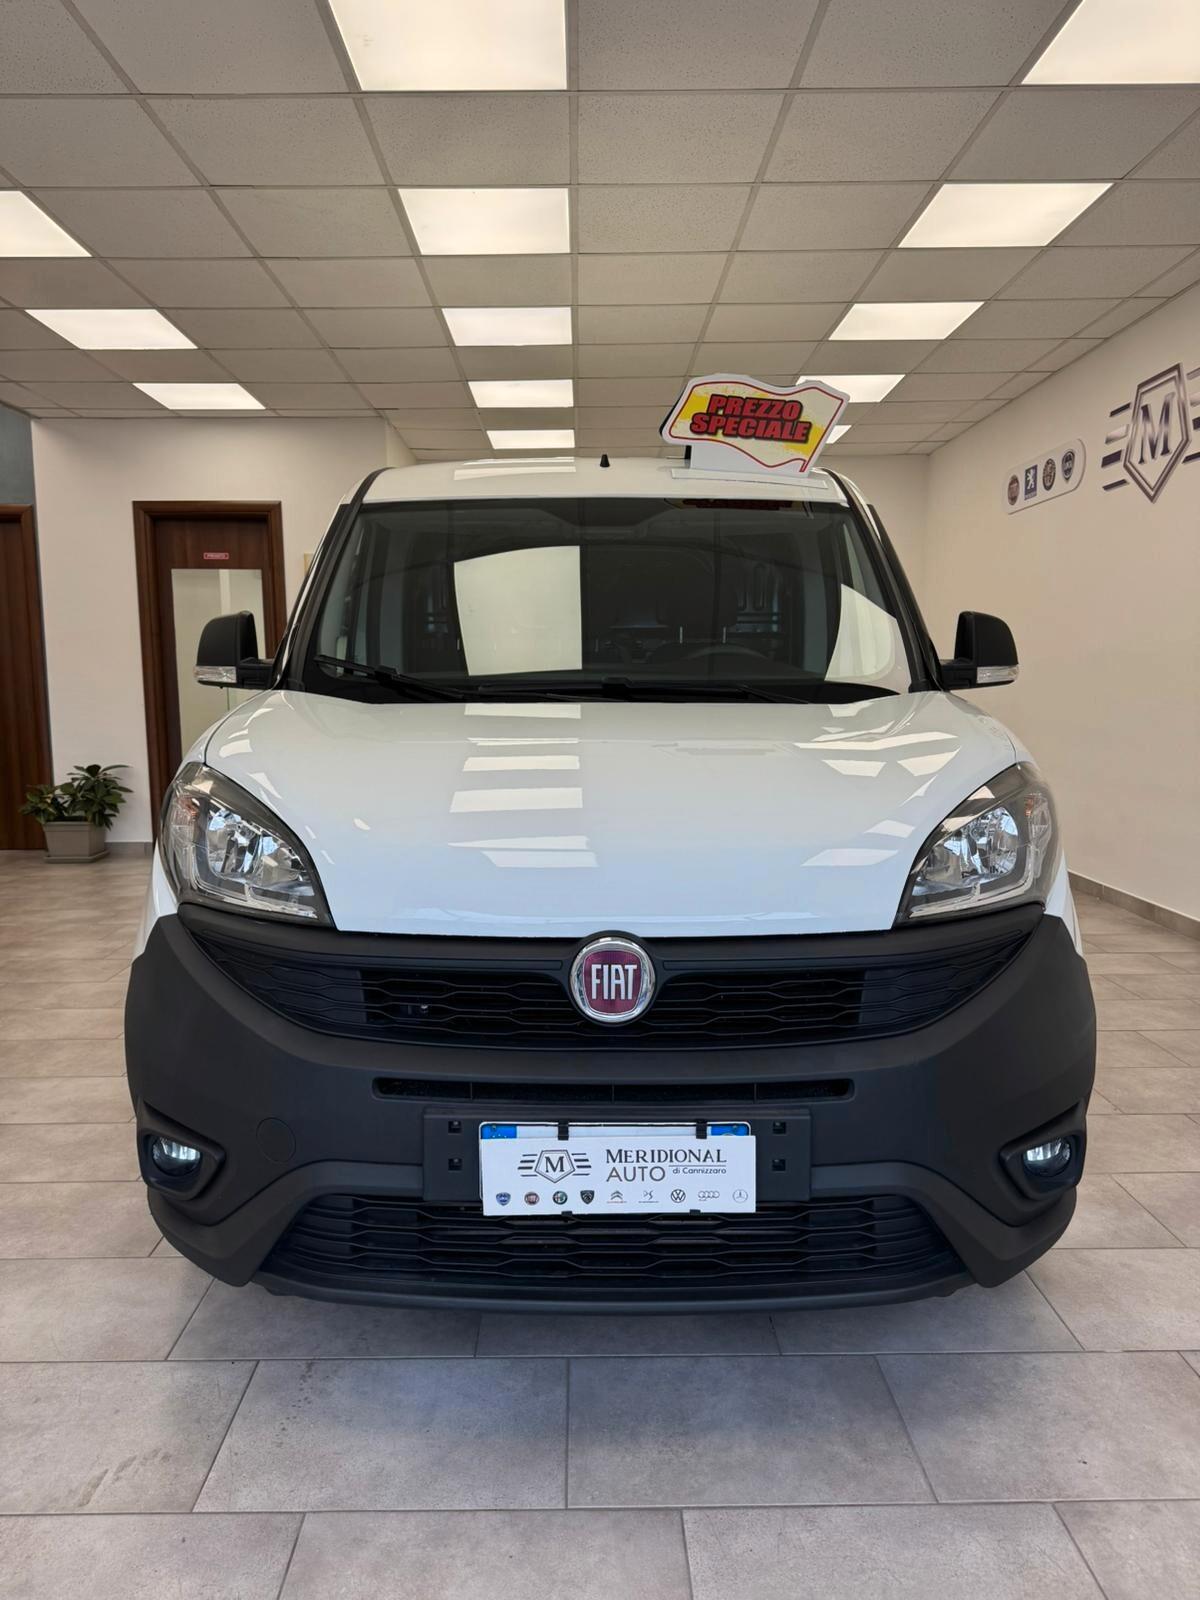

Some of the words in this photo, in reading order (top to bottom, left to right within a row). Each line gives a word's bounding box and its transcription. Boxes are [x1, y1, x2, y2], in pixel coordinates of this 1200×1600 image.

[707, 394, 803, 422] PREZZO
[689, 413, 812, 443] SPECIALE
[591, 964, 637, 1000] FIAT
[544, 1155, 565, 1173] M
[605, 1148, 727, 1163] MERIDIONAL
[606, 1166, 666, 1182] AUTO
[672, 1167, 681, 1175] di
[682, 1167, 727, 1175] Cannizzaro
